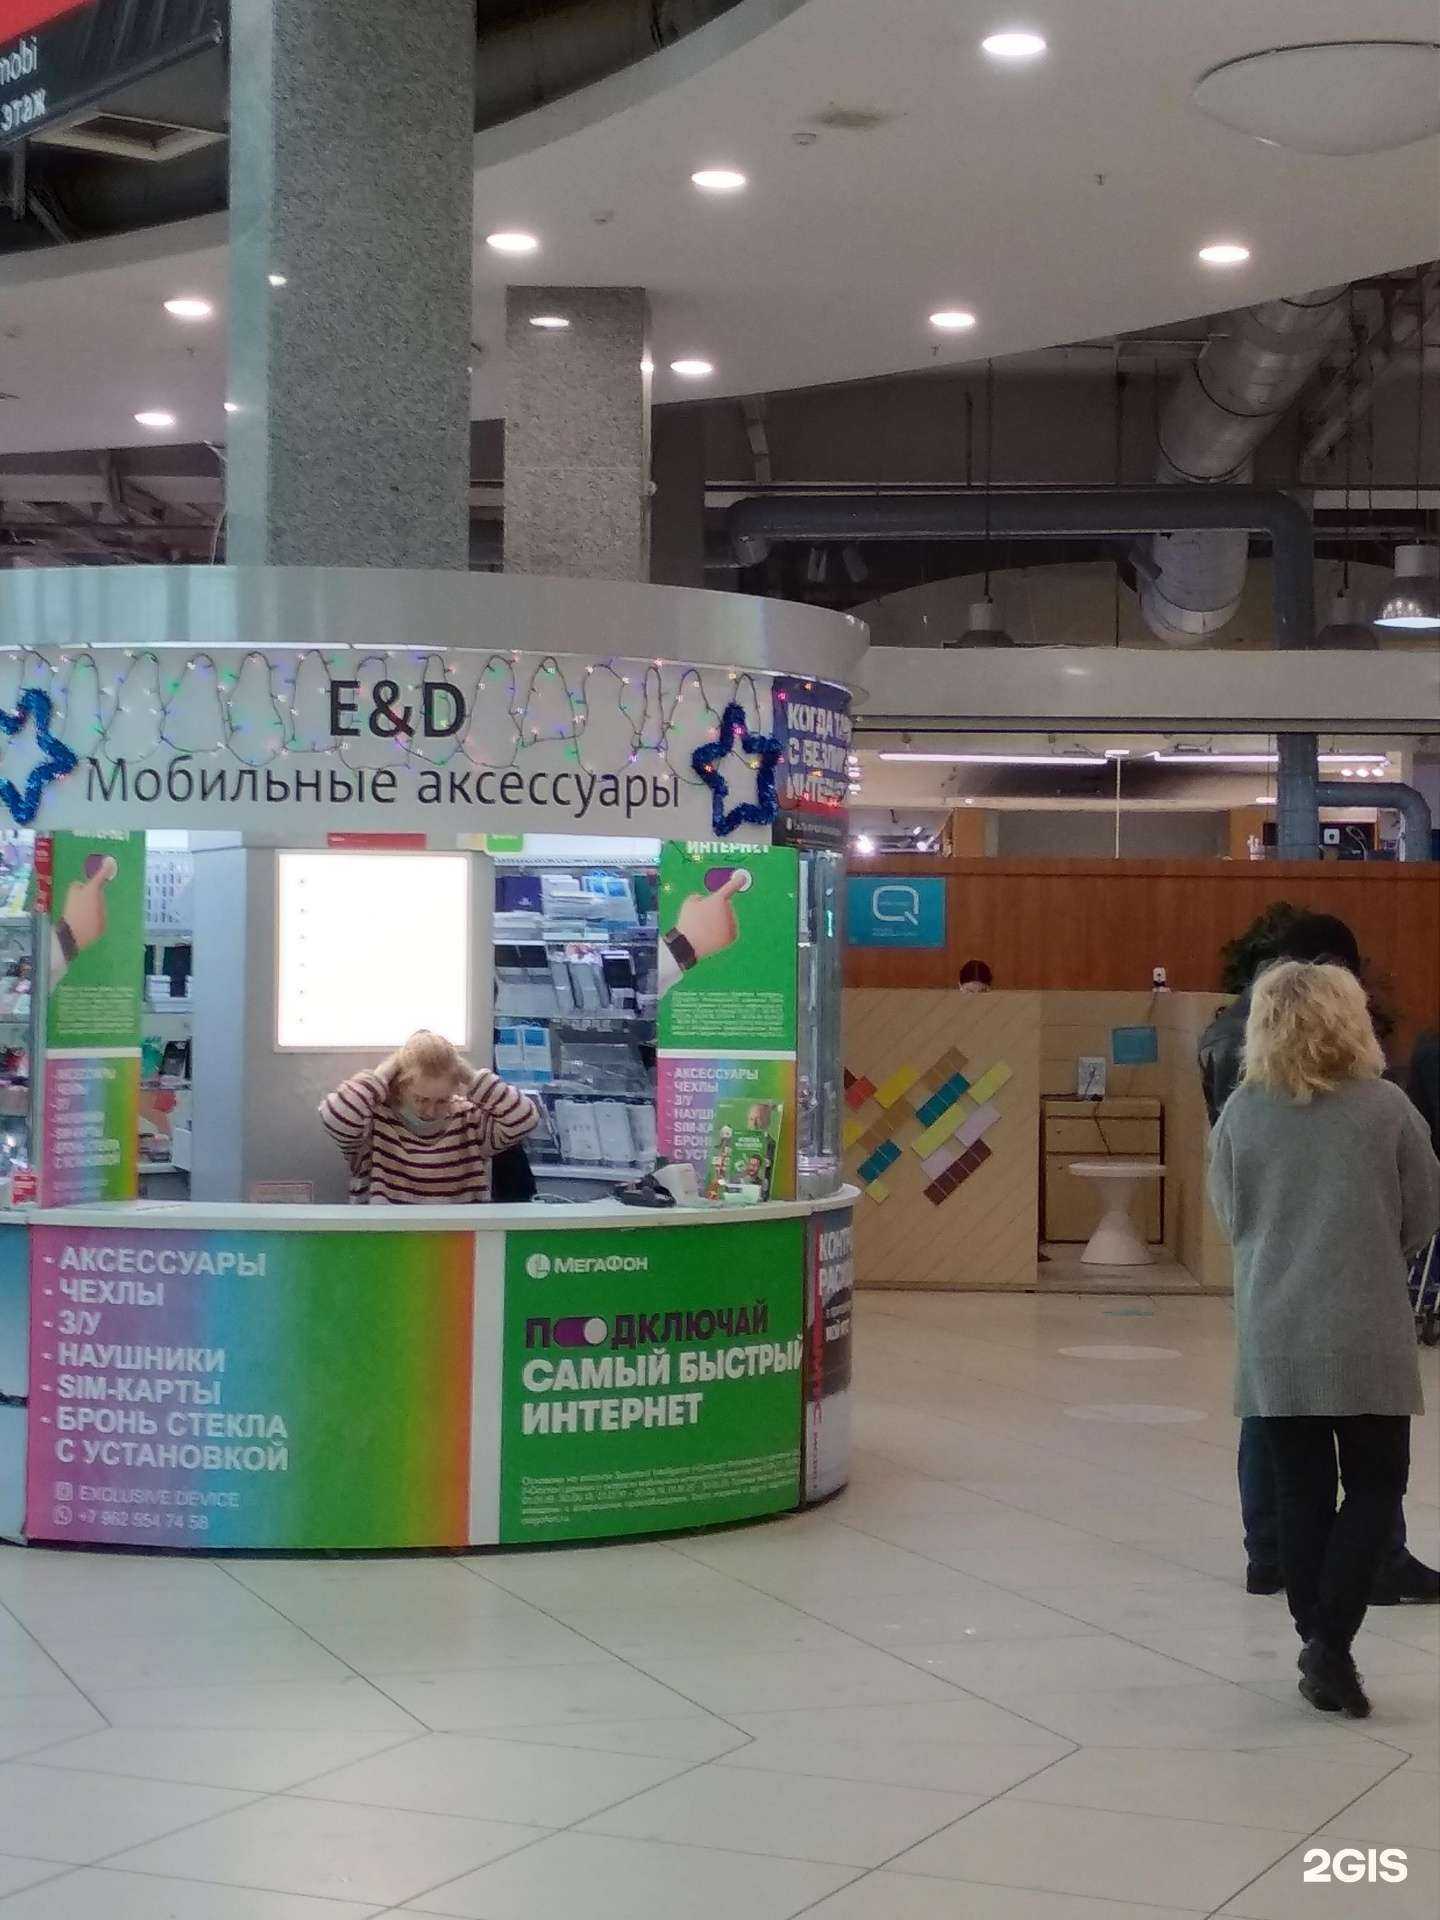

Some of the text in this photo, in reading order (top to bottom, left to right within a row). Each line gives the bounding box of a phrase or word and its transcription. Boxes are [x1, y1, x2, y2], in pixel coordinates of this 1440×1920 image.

[330, 679, 466, 738] E&D
[87, 754, 679, 819] Мобильные аксессуары
[58, 1246, 266, 1277] АКСЕССУАРЫ
[59, 1278, 165, 1306] ЧЕХЛЫ
[57, 1309, 101, 1335] З/У
[57, 1342, 226, 1373] НАУШНИКИ
[522, 1334, 803, 1393] САМЫЙ БЫСТРЫЙ
[57, 1374, 222, 1405] SIM-КАРТЫ
[56, 1406, 289, 1439] БРОНЬ СТЕКЛА
[522, 1392, 703, 1436] ИНТЕРНЕТ
[55, 1435, 290, 1471] С УСТАНОВКОЙ
[79, 1485, 241, 1508] EXCLUSIVE DEVICE
